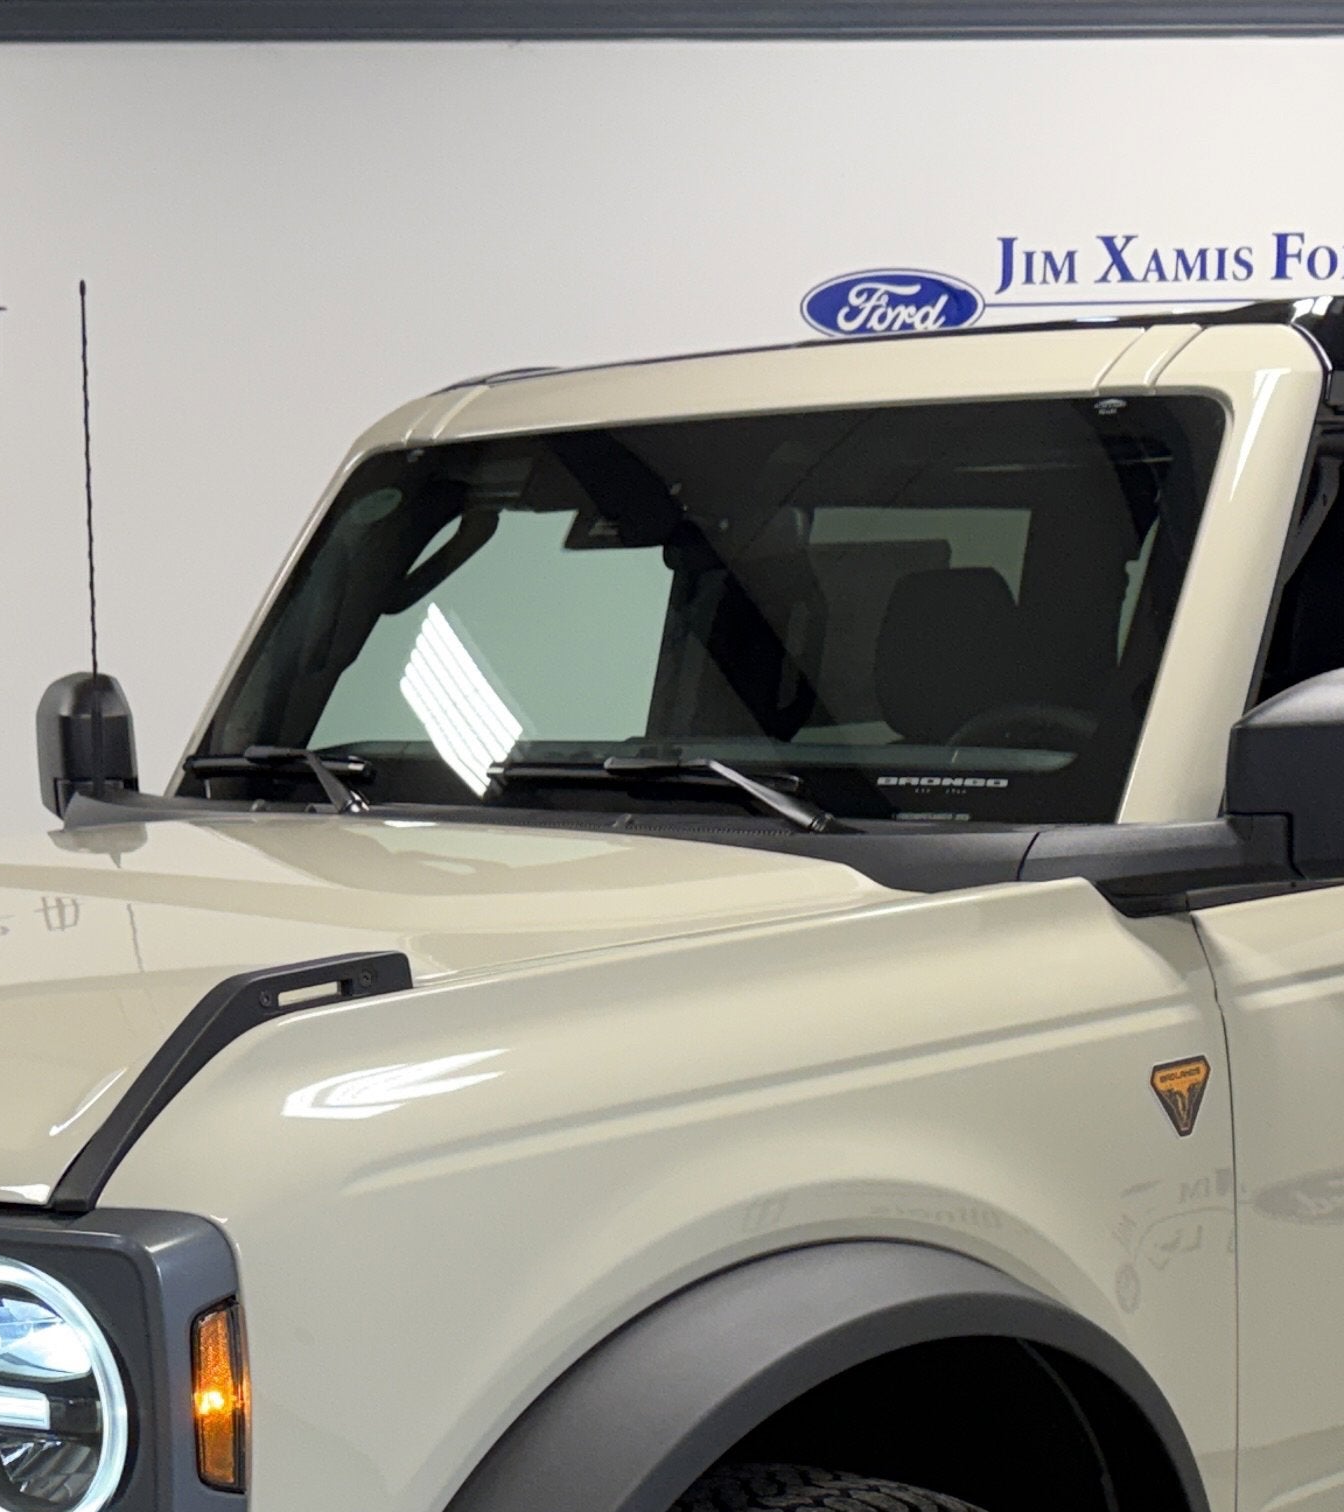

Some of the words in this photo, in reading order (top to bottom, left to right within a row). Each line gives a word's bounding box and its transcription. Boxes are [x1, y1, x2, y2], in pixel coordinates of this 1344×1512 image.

[994, 236, 1079, 295] JIM
[1094, 234, 1254, 284] XAMIS
[836, 282, 949, 333] Ford
